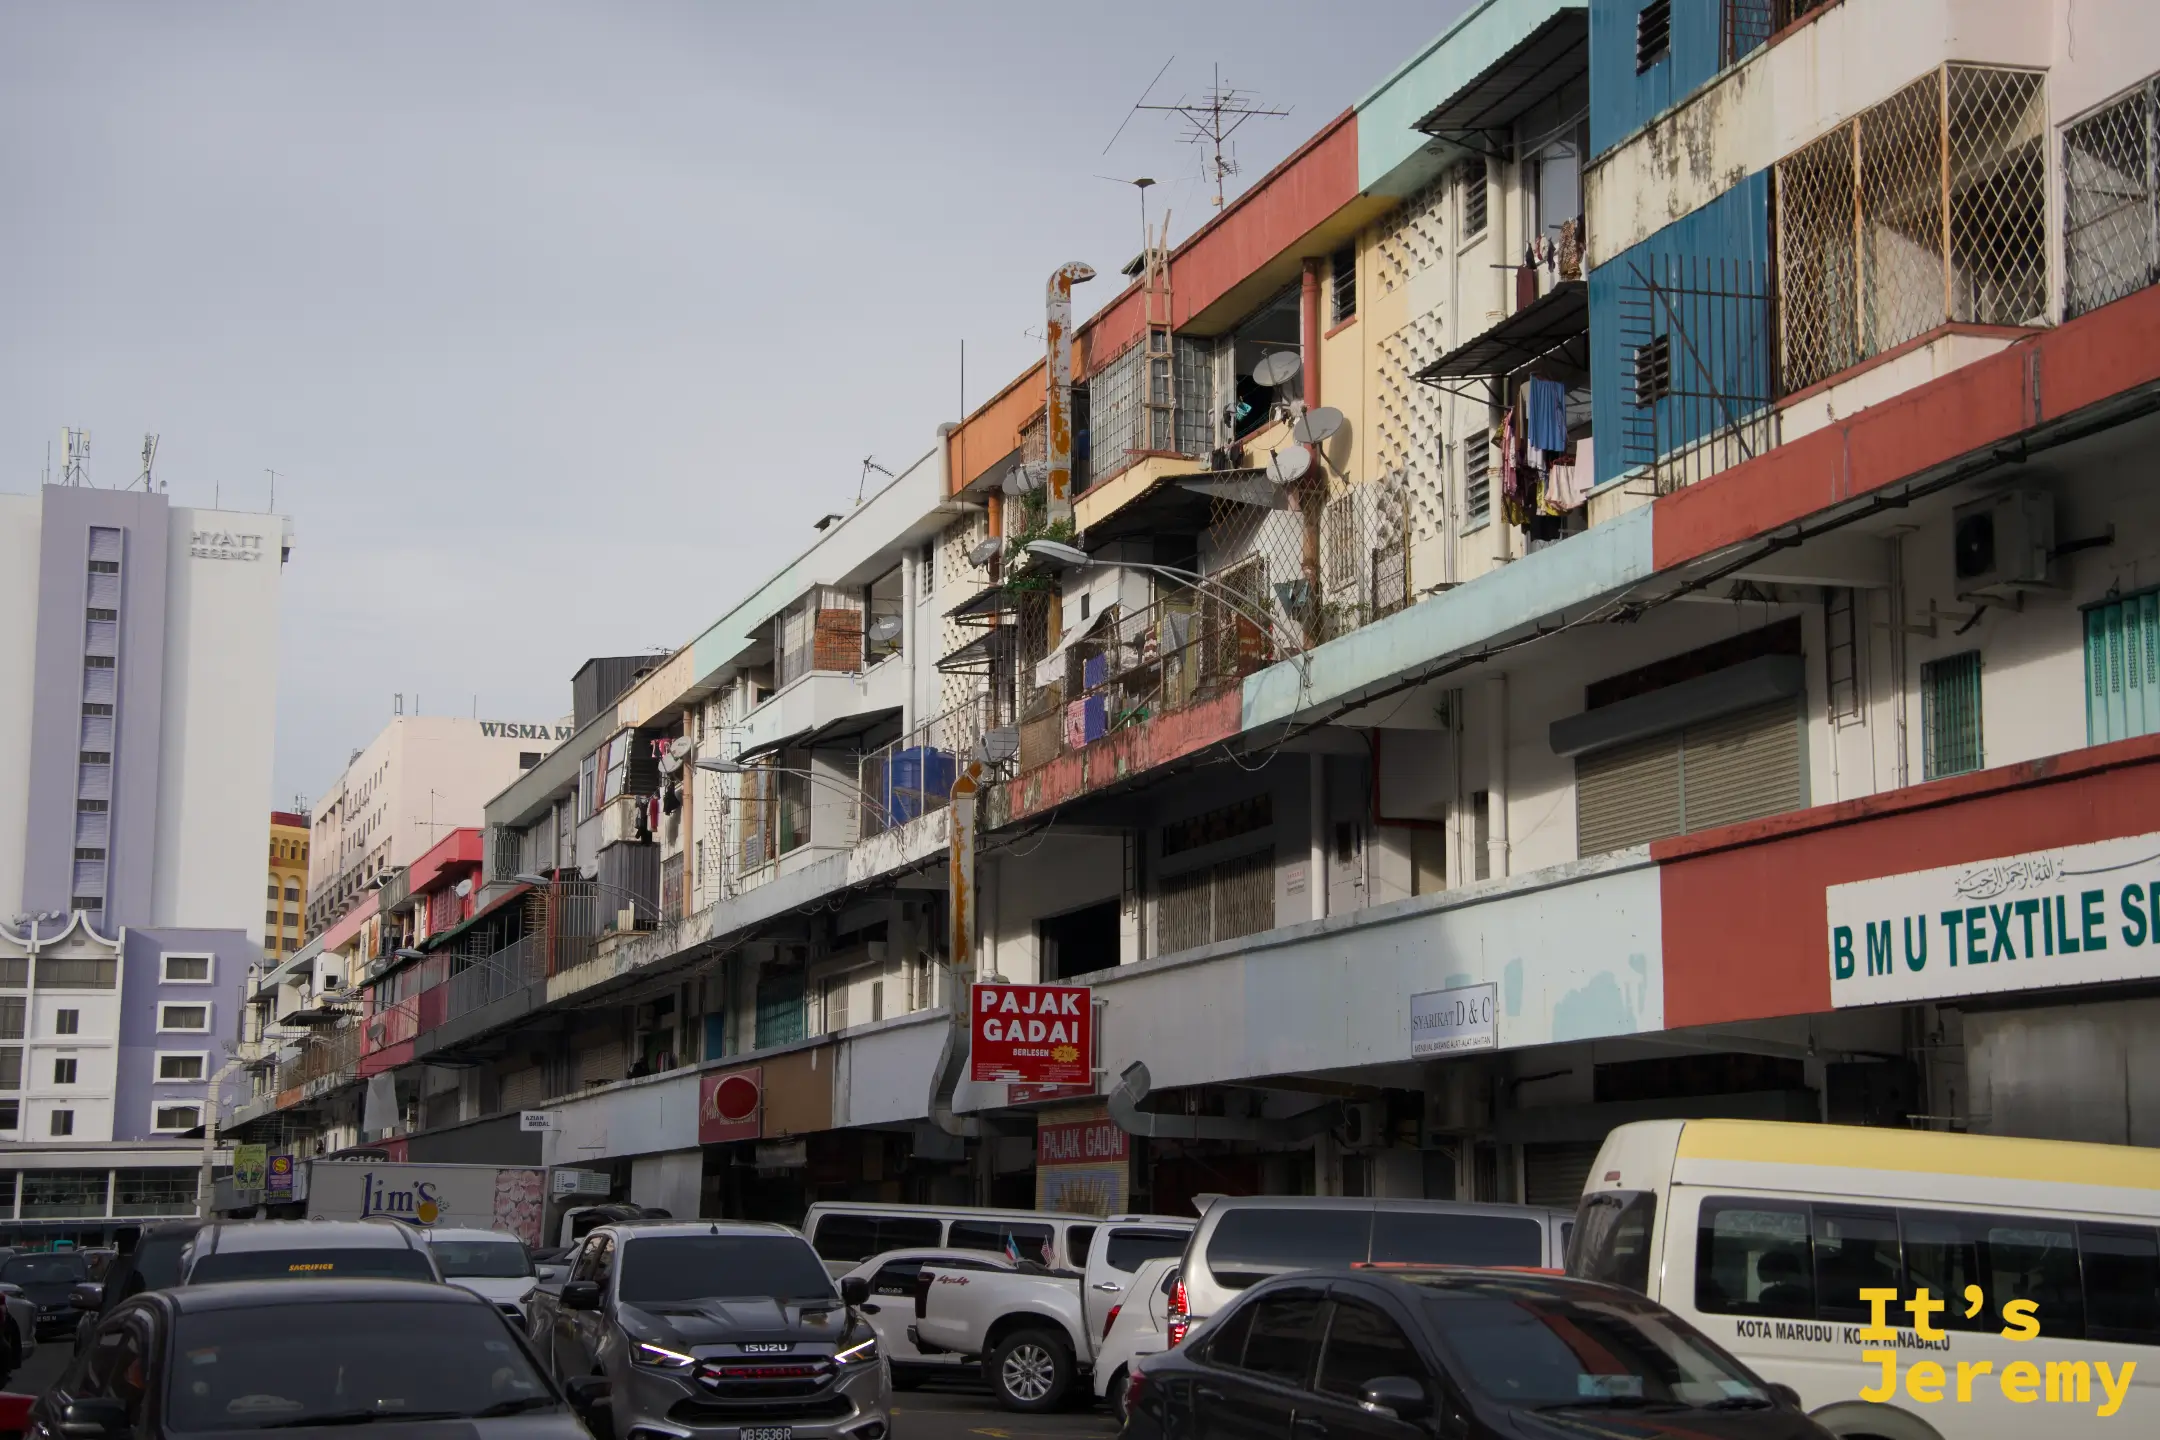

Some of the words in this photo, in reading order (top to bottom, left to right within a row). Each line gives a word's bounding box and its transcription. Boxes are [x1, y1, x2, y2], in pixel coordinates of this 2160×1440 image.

[191, 529, 264, 549] HYATT
[480, 721, 551, 740] WISMA
[555, 726, 574, 740] M
[1941, 889, 2107, 967] TEXTILE
[981, 990, 1081, 1015] PAJAK
[1413, 1010, 1455, 1031] SYARIKAT
[1456, 1000, 1465, 1026] D
[1469, 998, 1478, 1025] &
[1482, 996, 1491, 1023] C
[983, 1018, 1079, 1043] GADAI
[1012, 1048, 1049, 1057] BERLESEN
[1042, 1128, 1080, 1160] PAJAK
[1085, 1125, 1123, 1157] GADAI
[289, 1263, 334, 1272] SACRIFICE
[937, 1274, 970, 1286] 4x4
[1736, 1320, 1772, 1339] KOTA
[1776, 1322, 1832, 1343] MARUDU
[745, 1343, 788, 1352] ISUZU
[740, 1427, 792, 1440] WB5636R
